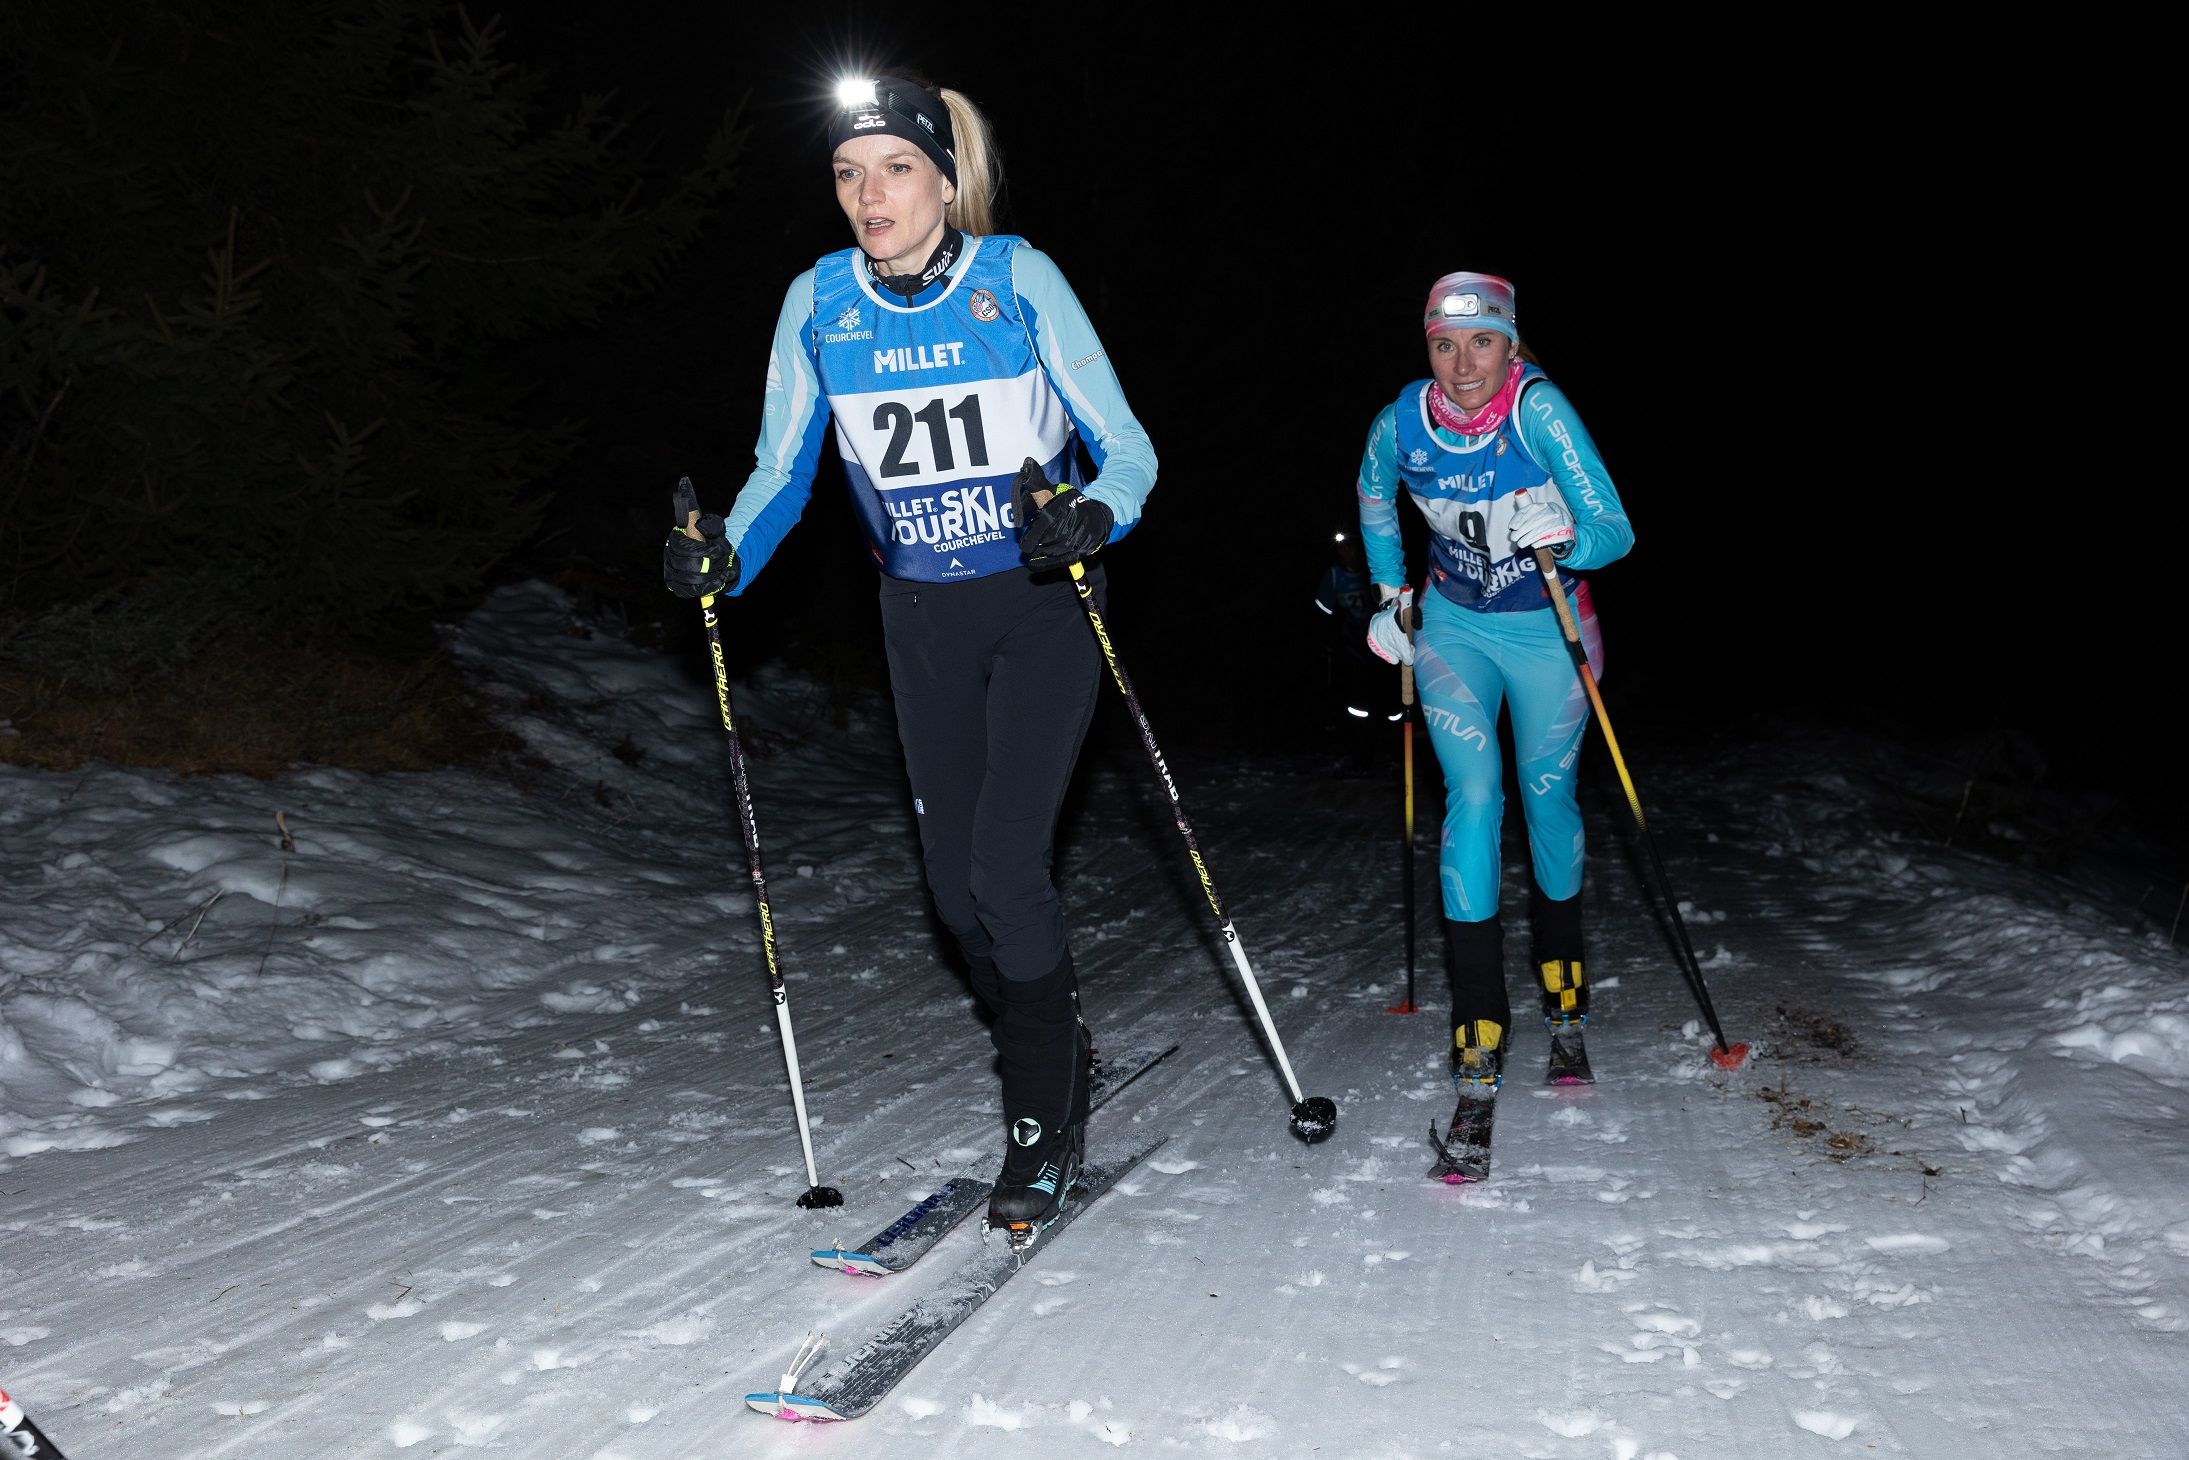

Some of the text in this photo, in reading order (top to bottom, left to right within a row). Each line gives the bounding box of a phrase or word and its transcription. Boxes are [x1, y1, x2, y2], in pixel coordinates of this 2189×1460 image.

[917, 114, 934, 133] PETZL
[825, 331, 874, 343] COURCHEVEL
[873, 341, 964, 374] MILLET
[873, 394, 989, 478] 211
[1529, 392, 1604, 516] LA SPORTIVA
[1438, 471, 1495, 494] MILLET
[882, 485, 999, 522] ILLET SKI
[934, 531, 1006, 553] COURCHEVEL
[941, 569, 976, 578] DYNASTAR
